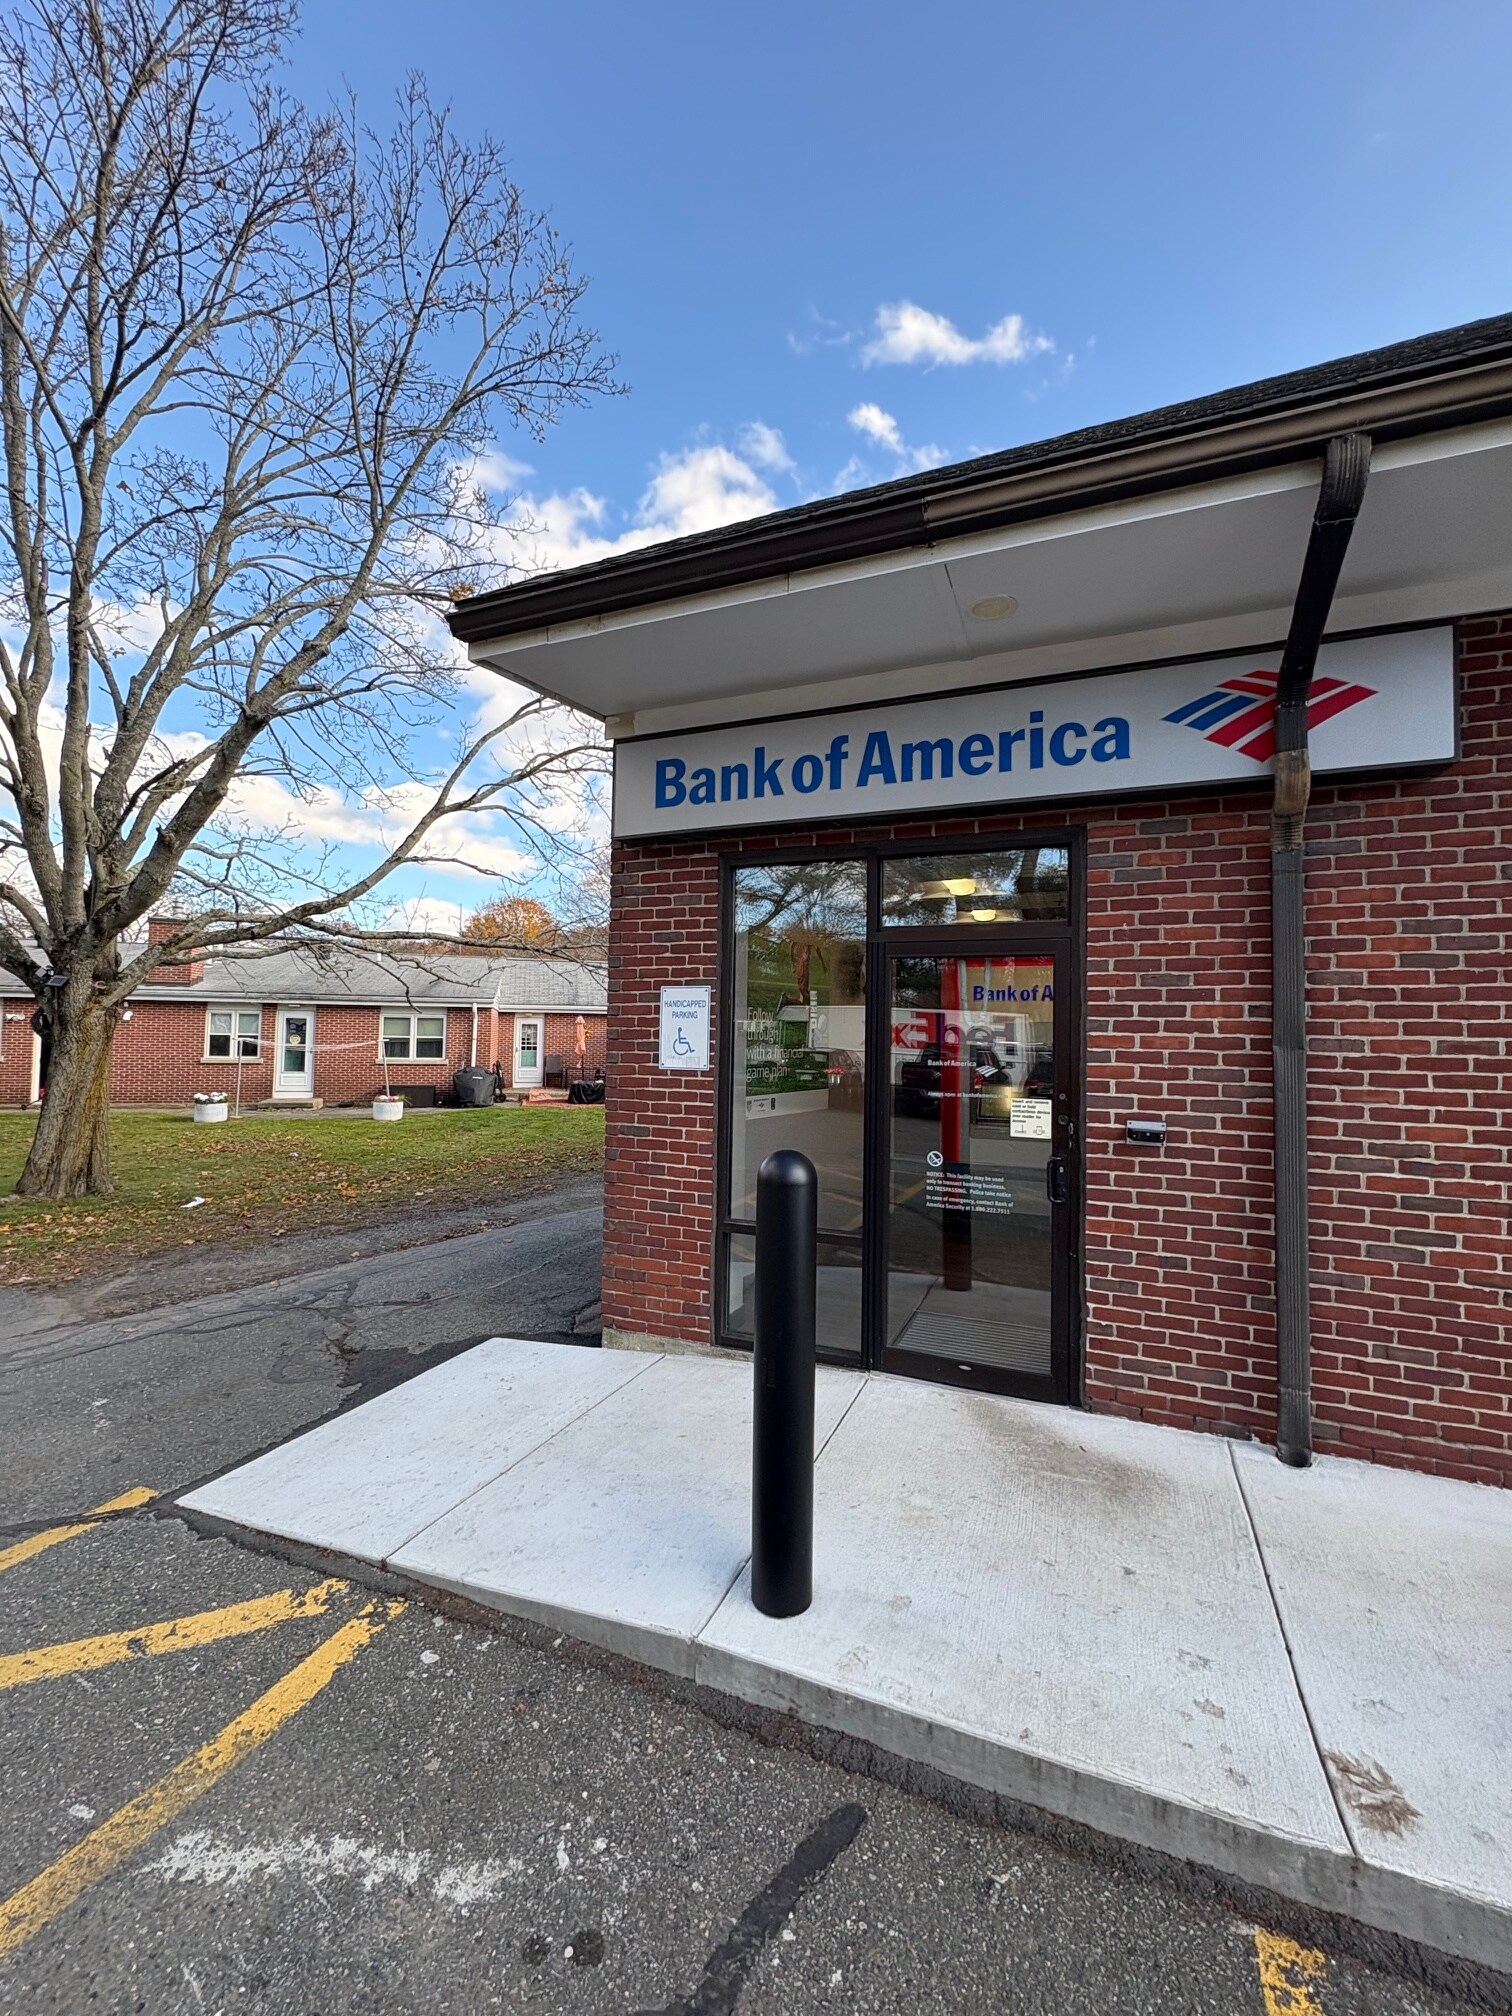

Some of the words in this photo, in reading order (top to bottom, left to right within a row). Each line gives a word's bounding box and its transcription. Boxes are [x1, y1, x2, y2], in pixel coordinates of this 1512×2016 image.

[655, 746, 785, 808] Bank
[792, 735, 850, 793] of
[857, 709, 1131, 788] America
[973, 985, 1019, 1002] Bank
[1020, 985, 1038, 1002] of
[664, 1000, 707, 1008] HANDICAPPED
[671, 1011, 699, 1019] PARKING
[747, 1007, 774, 1022] Follow
[747, 1022, 779, 1044] through
[747, 1045, 765, 1060] with
[766, 1048, 772, 1060] a
[773, 1044, 804, 1060] financial
[927, 1059, 944, 1067] Bank
[746, 1067, 770, 1083] game
[771, 1062, 788, 1080] plan
[963, 1181, 982, 1189] banking
[934, 1186, 968, 1194] TRESPASSING.
[949, 1197, 975, 1205] emergency,
[946, 1203, 966, 1211] Security
